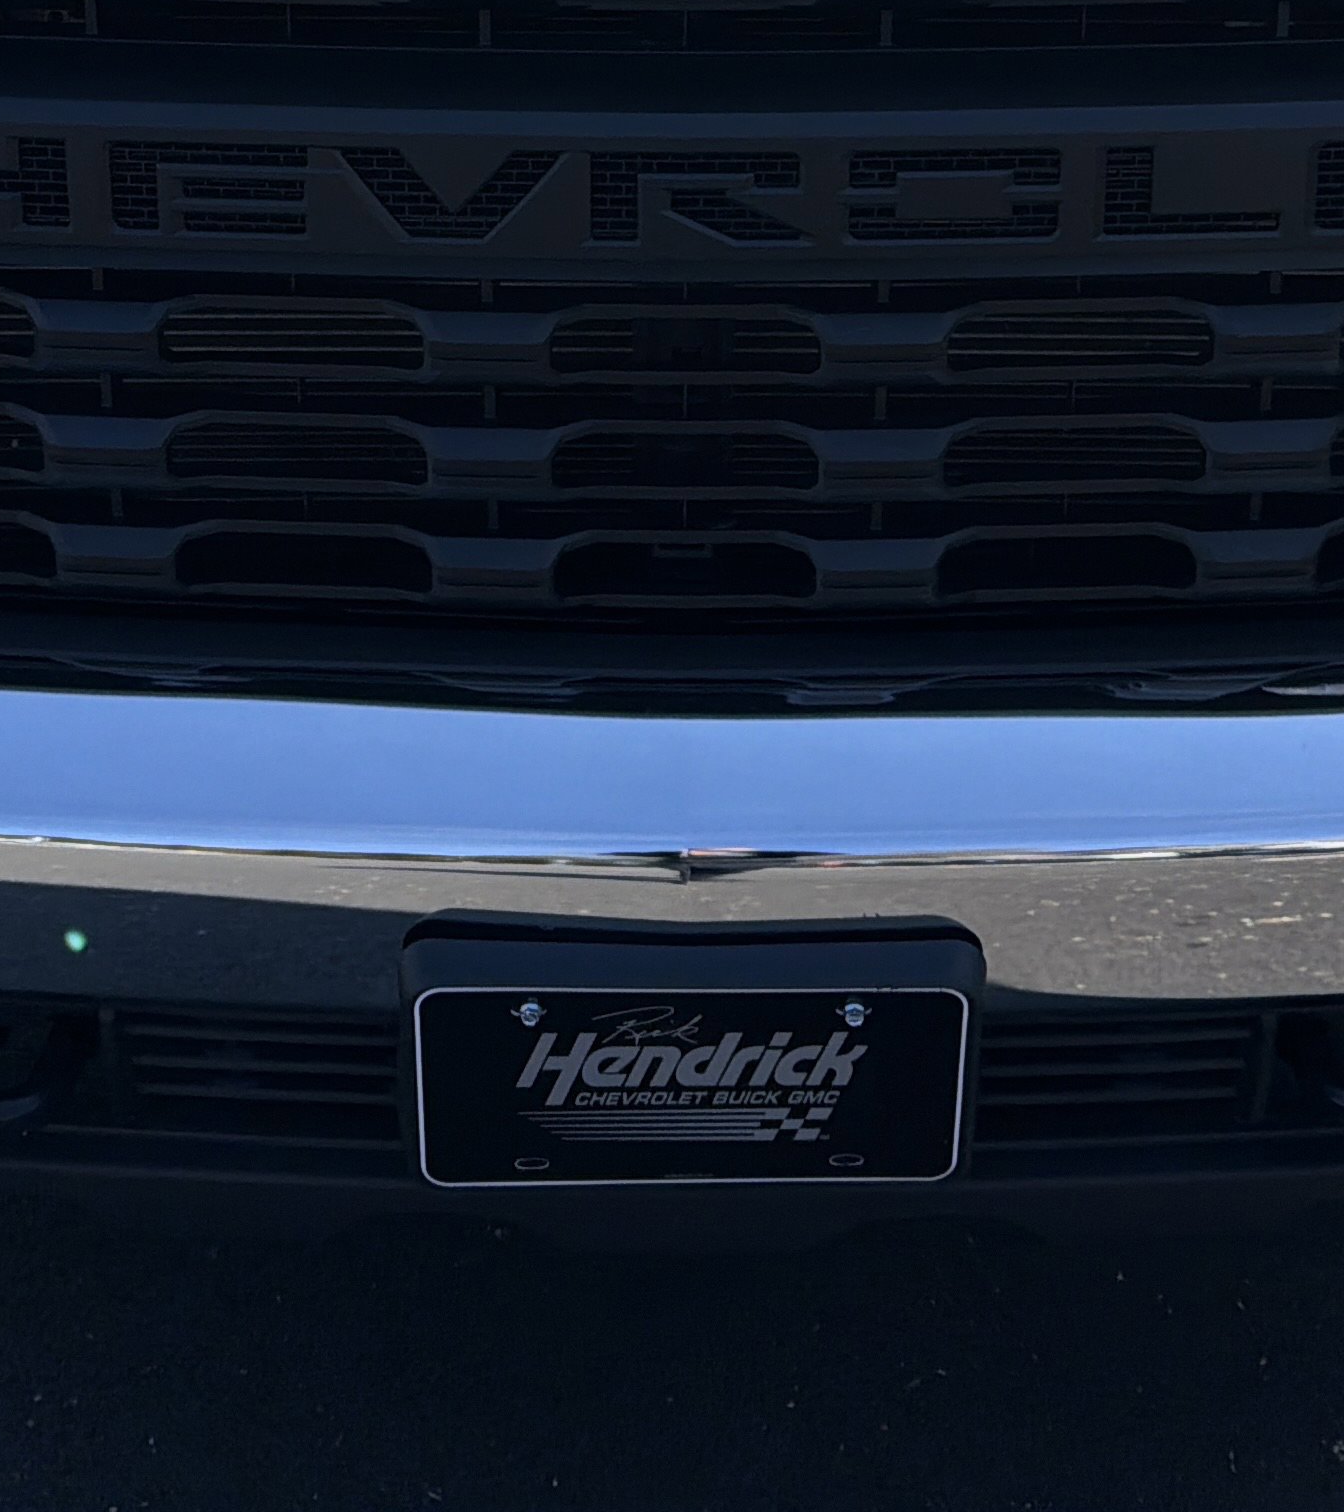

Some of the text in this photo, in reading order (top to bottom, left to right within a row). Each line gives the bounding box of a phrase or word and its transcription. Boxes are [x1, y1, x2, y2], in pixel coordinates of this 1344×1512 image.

[515, 1031, 869, 1106] Hendrick
[574, 1090, 841, 1107] CHEVROLET BUICK GMC
